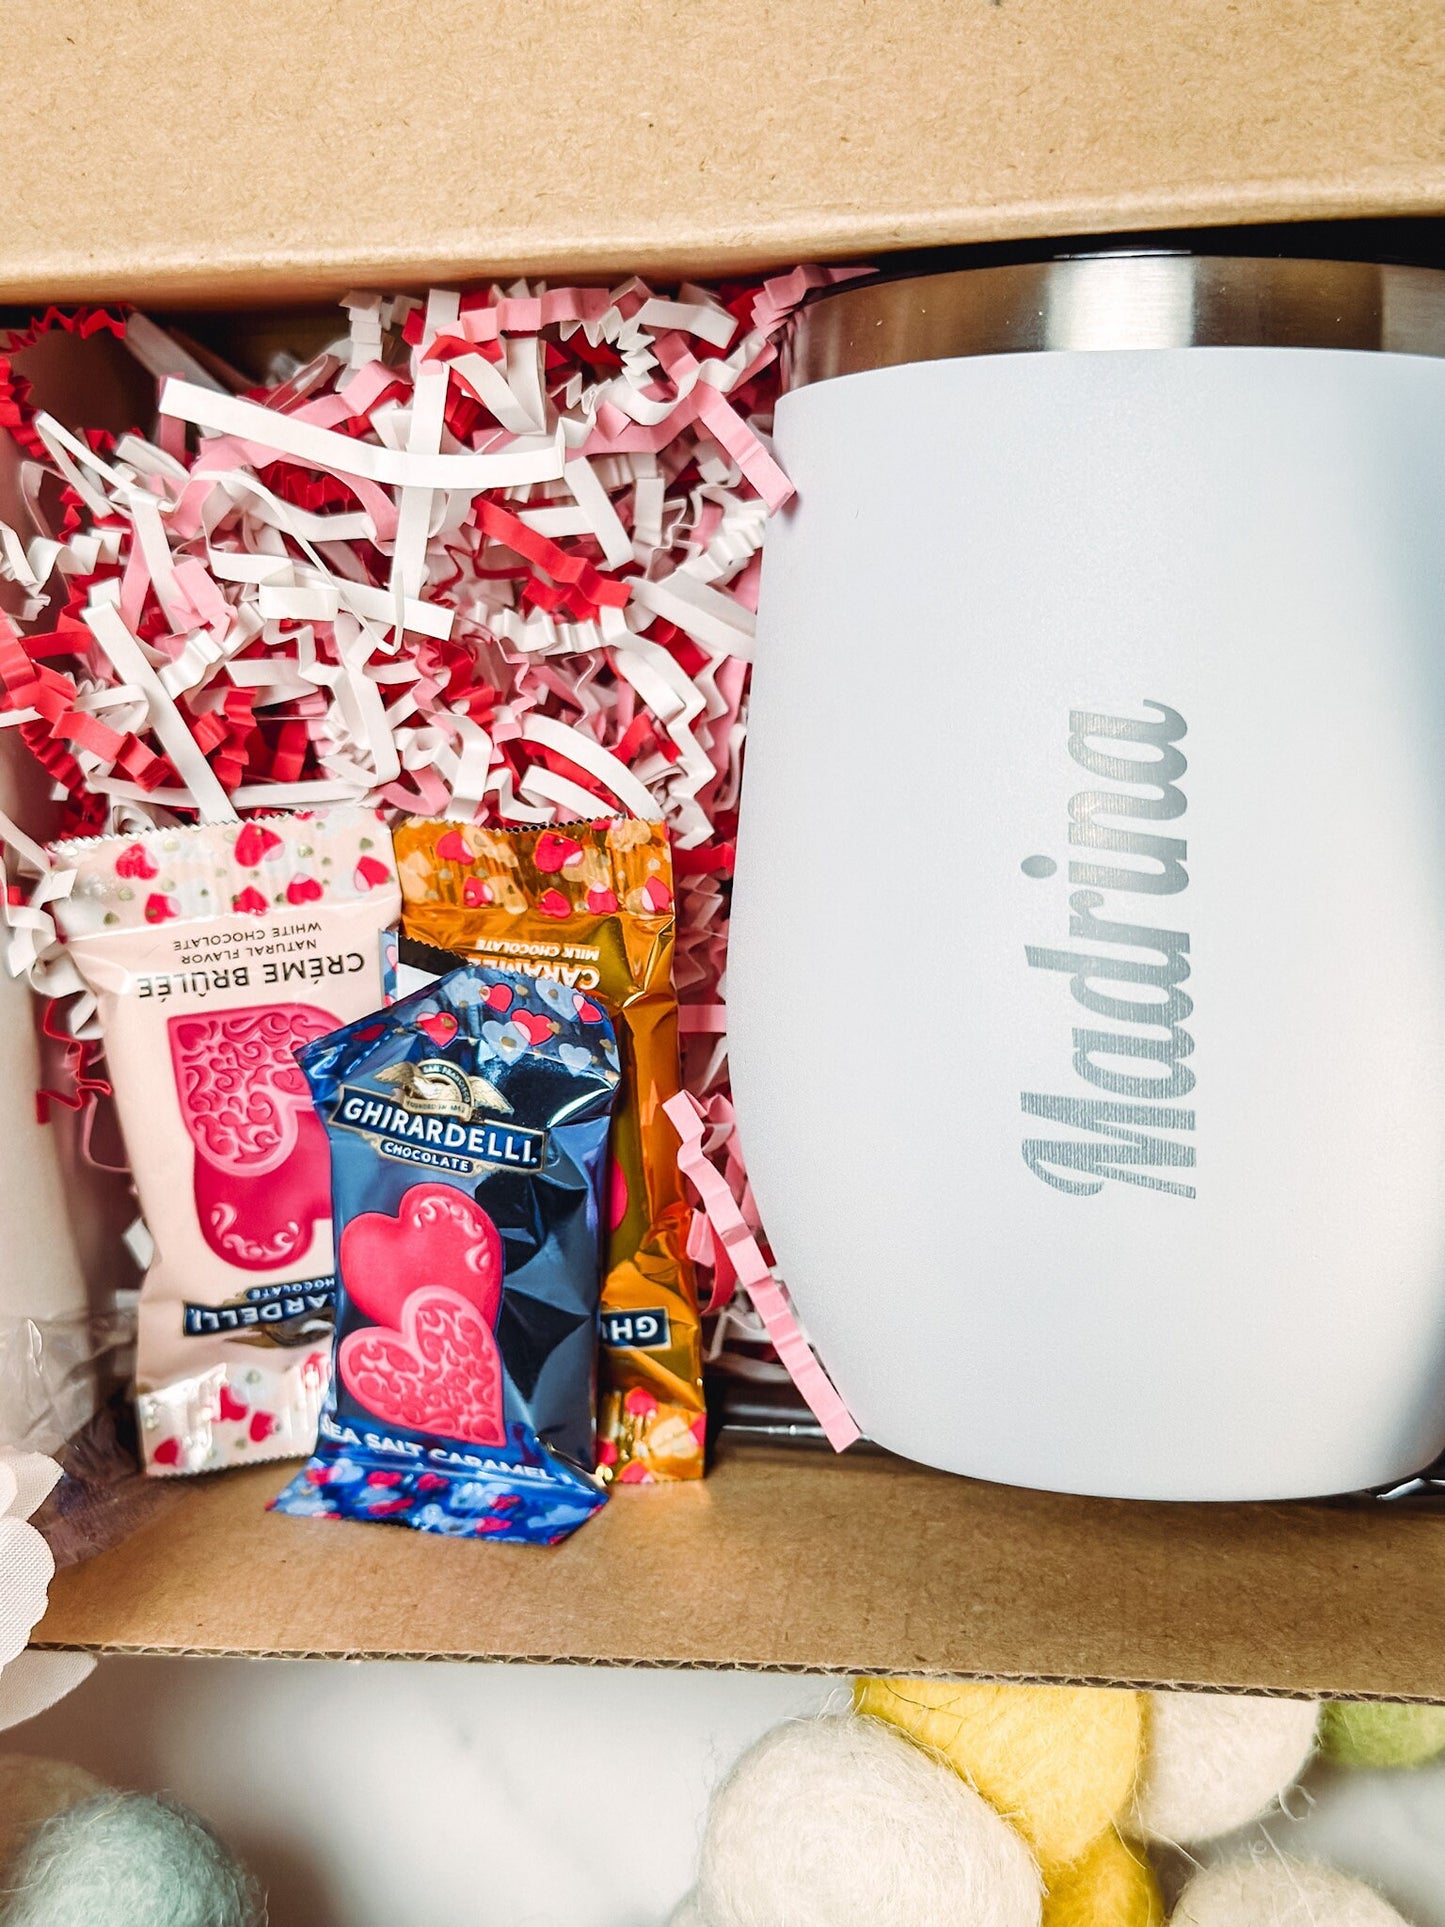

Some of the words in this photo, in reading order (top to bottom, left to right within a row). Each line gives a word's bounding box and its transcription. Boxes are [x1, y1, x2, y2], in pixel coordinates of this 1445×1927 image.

[271, 921, 322, 938] WHITE
[172, 930, 266, 951] CHOCOLATE
[246, 939, 317, 958] NATURAL
[475, 938, 561, 957] CHOCOLATE
[1020, 698, 1197, 1200] Madrina
[181, 948, 240, 965] FLAVOR
[561, 945, 600, 961] MILK
[136, 966, 250, 1003] BRÛLÉE
[384, 1141, 470, 1173] CHOCOLATE
[251, 1277, 336, 1300] HOCOLATE
[364, 1432, 424, 1458] SALT
[428, 1448, 556, 1481] CARAMEL
